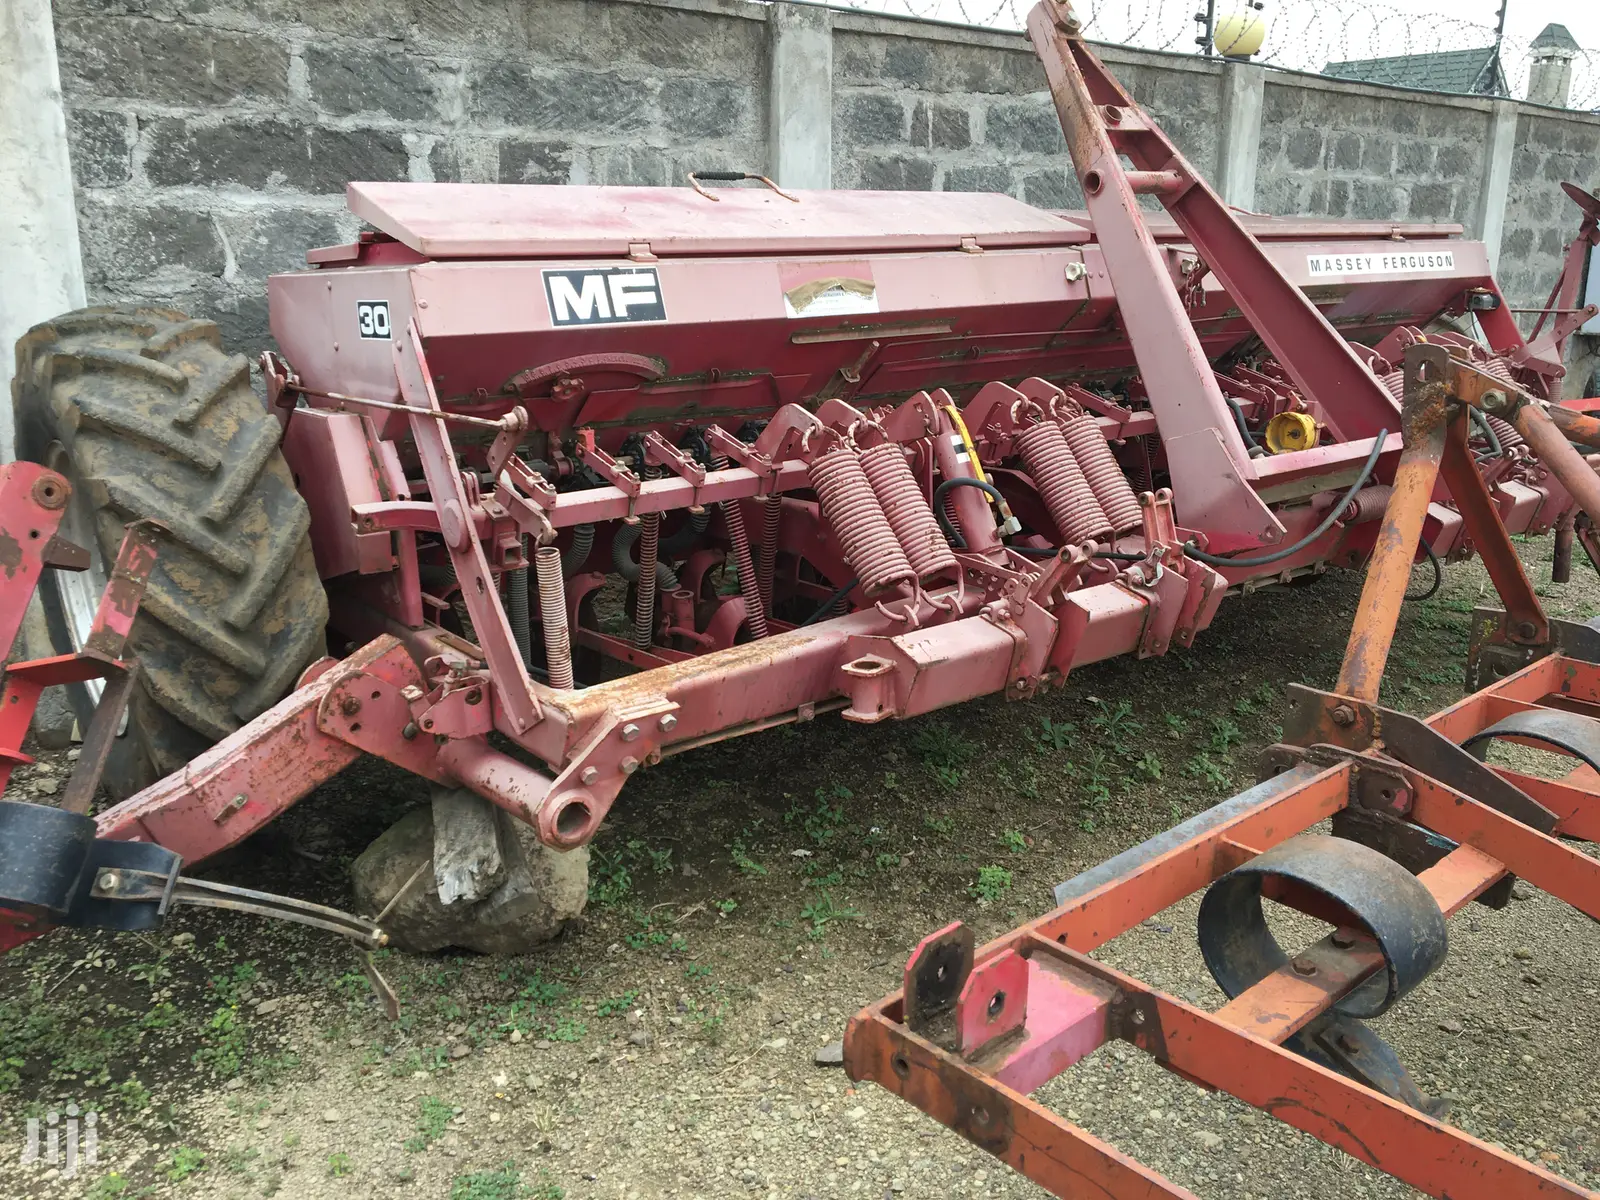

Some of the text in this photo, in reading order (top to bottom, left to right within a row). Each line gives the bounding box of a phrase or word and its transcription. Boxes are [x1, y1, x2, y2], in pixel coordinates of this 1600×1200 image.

[1310, 255, 1453, 272] MASSEY FERGUSON
[548, 272, 658, 321] MF
[359, 305, 391, 336] 30
